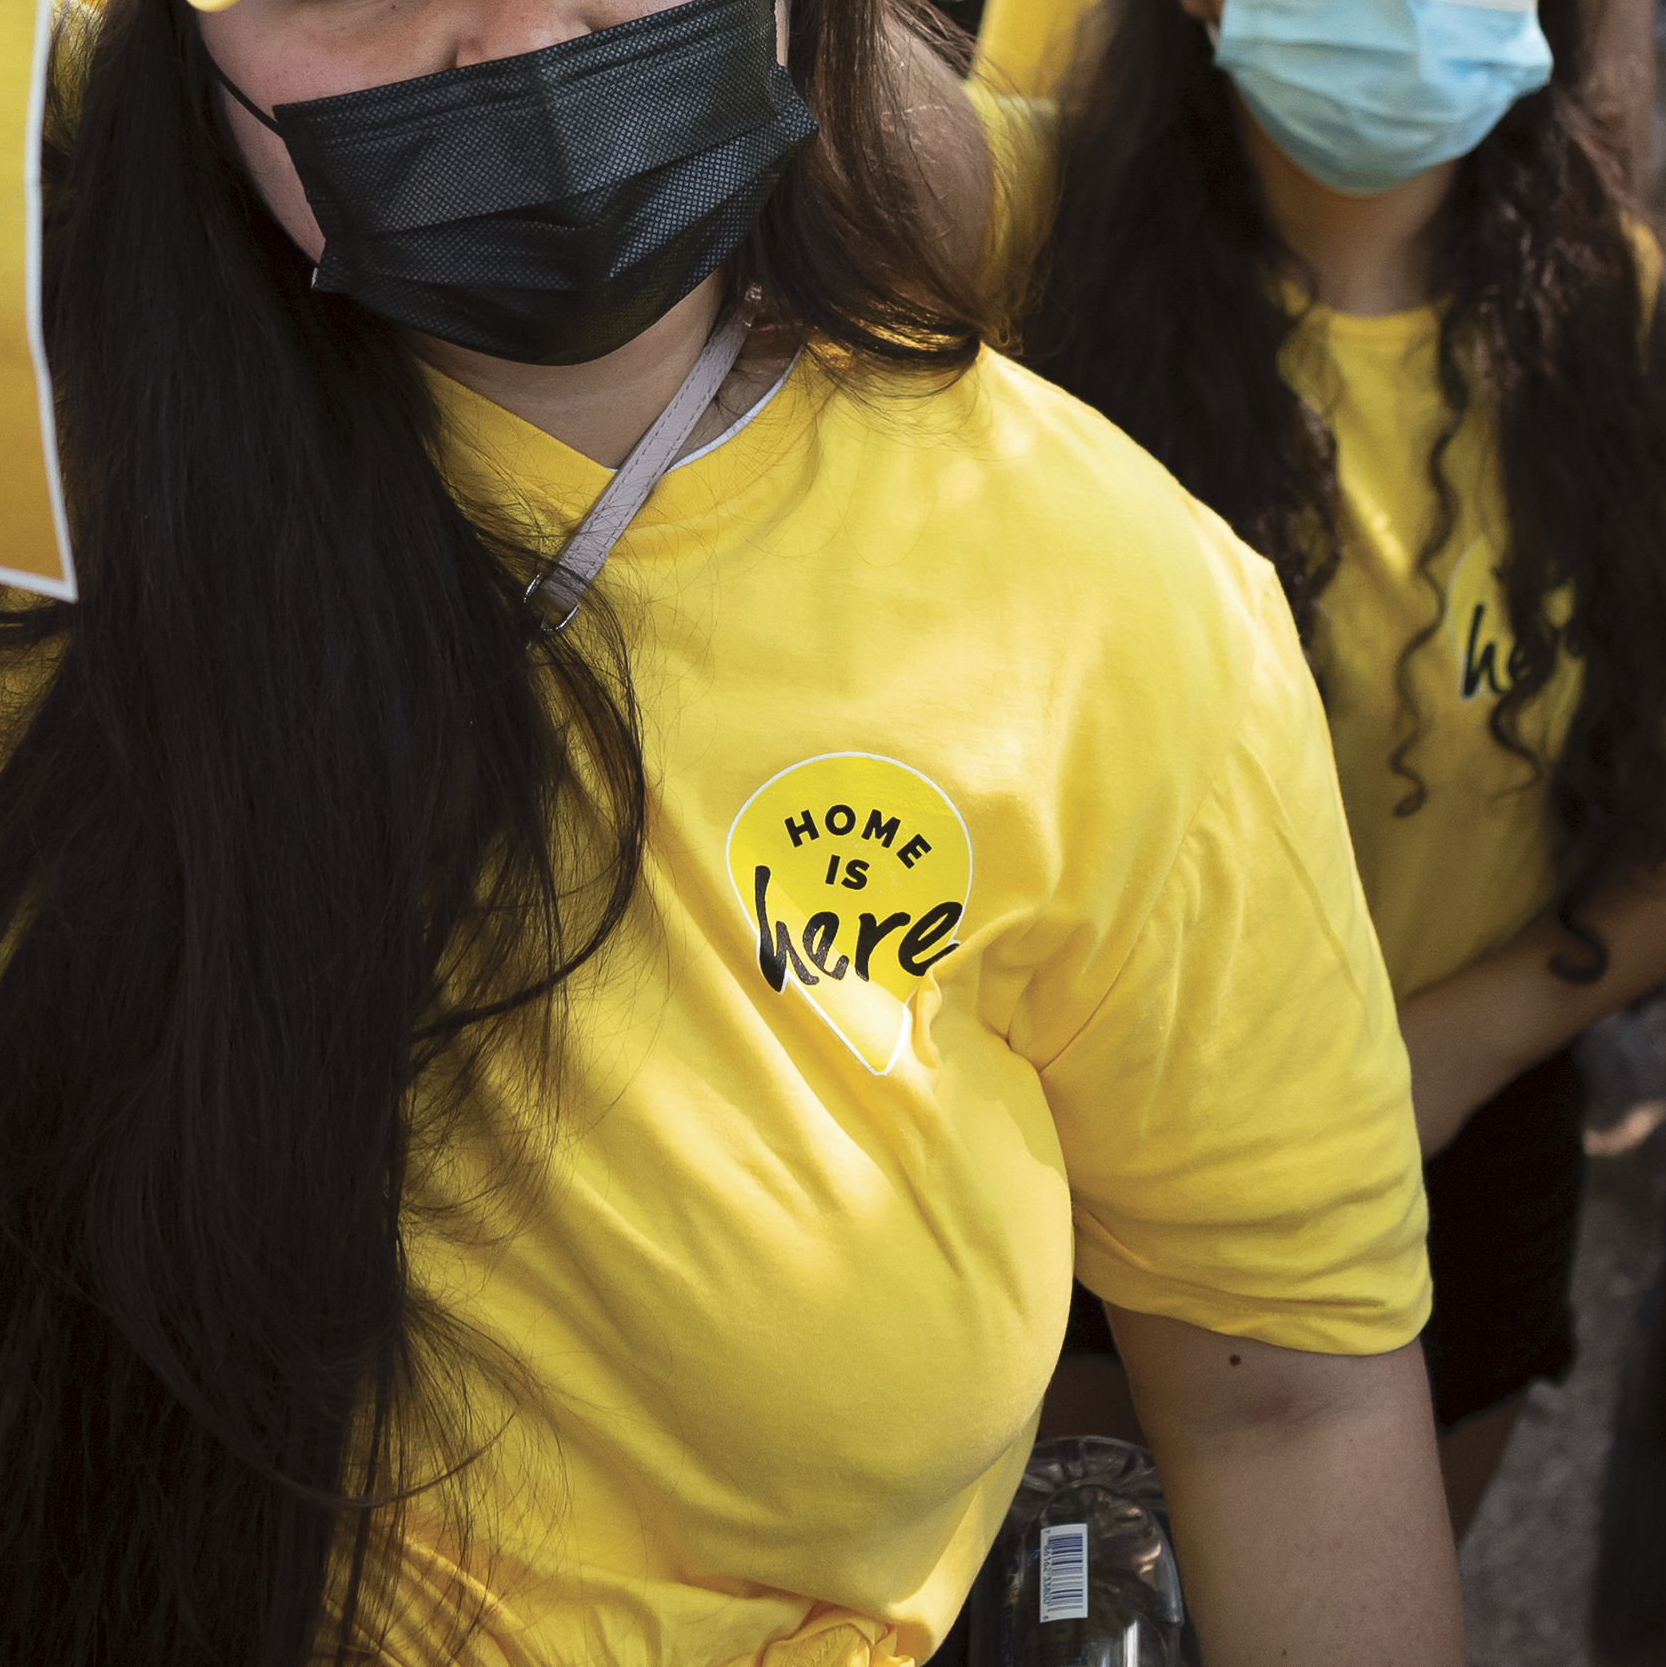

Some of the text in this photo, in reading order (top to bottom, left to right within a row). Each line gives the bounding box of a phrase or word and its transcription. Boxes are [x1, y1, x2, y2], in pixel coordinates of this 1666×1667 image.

[783, 804, 933, 869] HOME
[824, 854, 871, 891] IS
[754, 864, 964, 994] here
